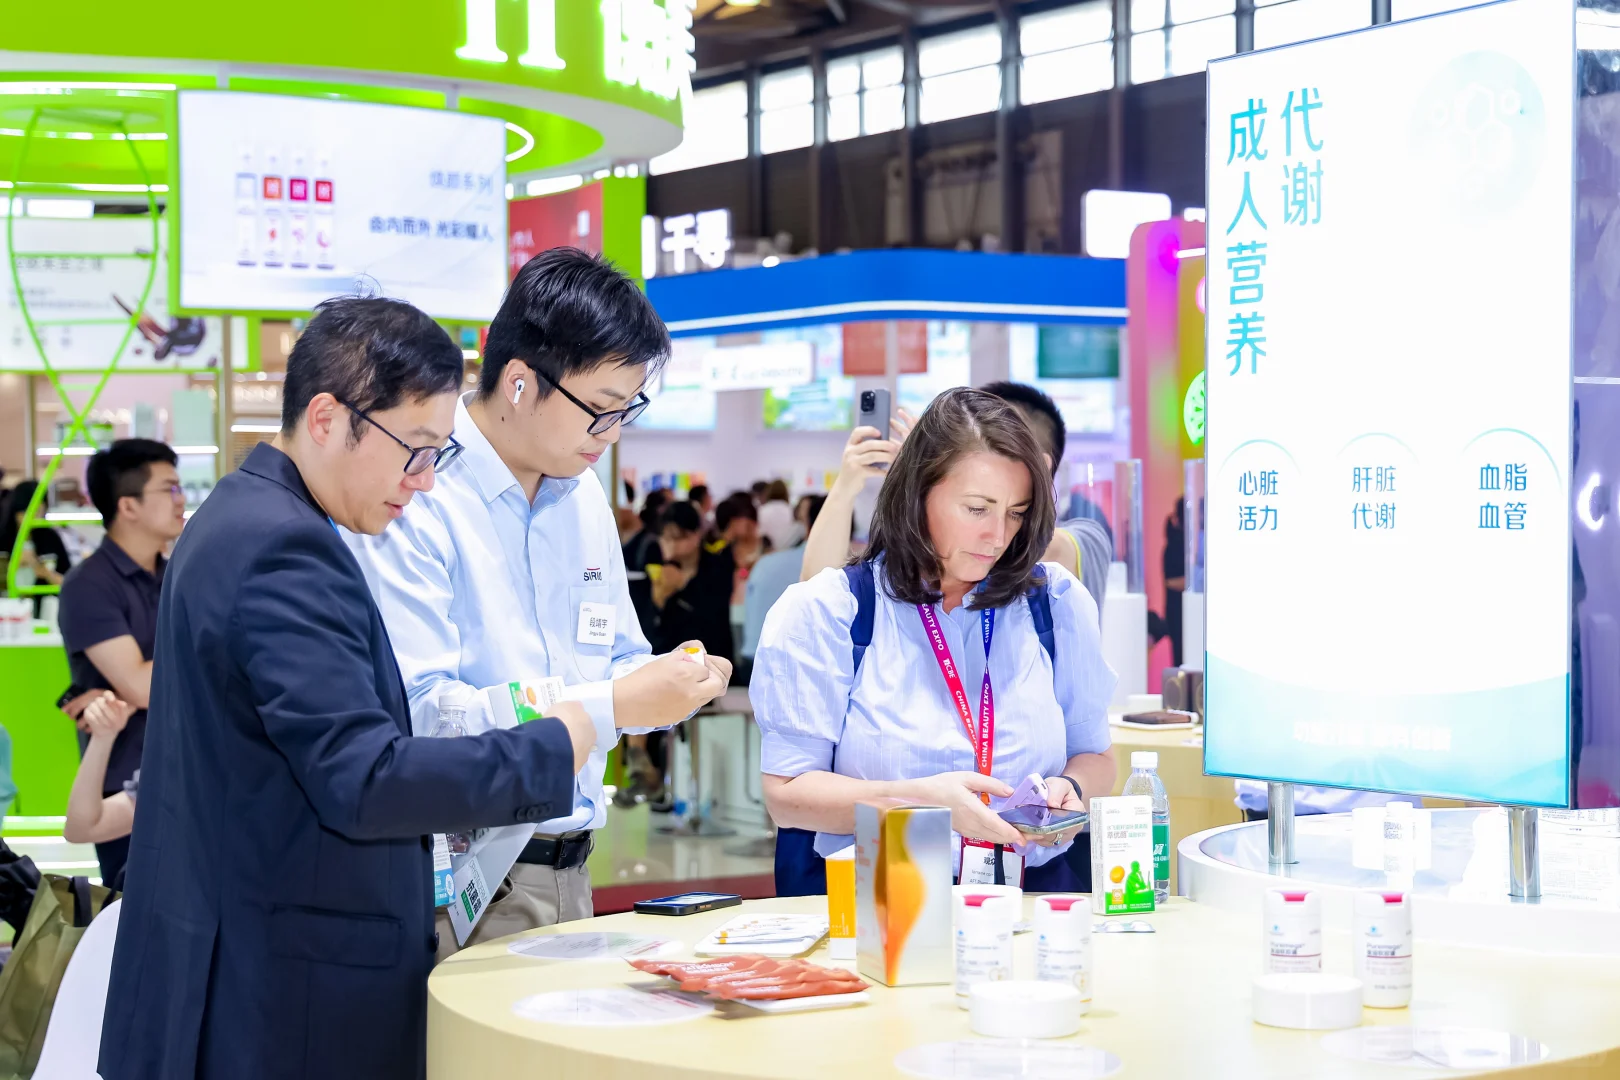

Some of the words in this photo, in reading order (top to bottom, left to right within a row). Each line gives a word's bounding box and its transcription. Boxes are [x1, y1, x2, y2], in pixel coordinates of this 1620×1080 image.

[1280, 87, 1324, 228] 代谢
[1226, 98, 1269, 377] 成人营养
[1238, 469, 1279, 496] 心脏
[1351, 465, 1397, 493] 肝脏
[1478, 462, 1528, 491] 血脂
[1238, 504, 1279, 531] 活力
[1351, 501, 1396, 530] 代谢
[1477, 502, 1528, 531] 血管
[921, 603, 937, 628] EAUTY
[931, 626, 945, 651] EXPO
[955, 690, 968, 717] CHINA
[982, 705, 991, 739] BEAUTY
[981, 740, 989, 768] CHINA
